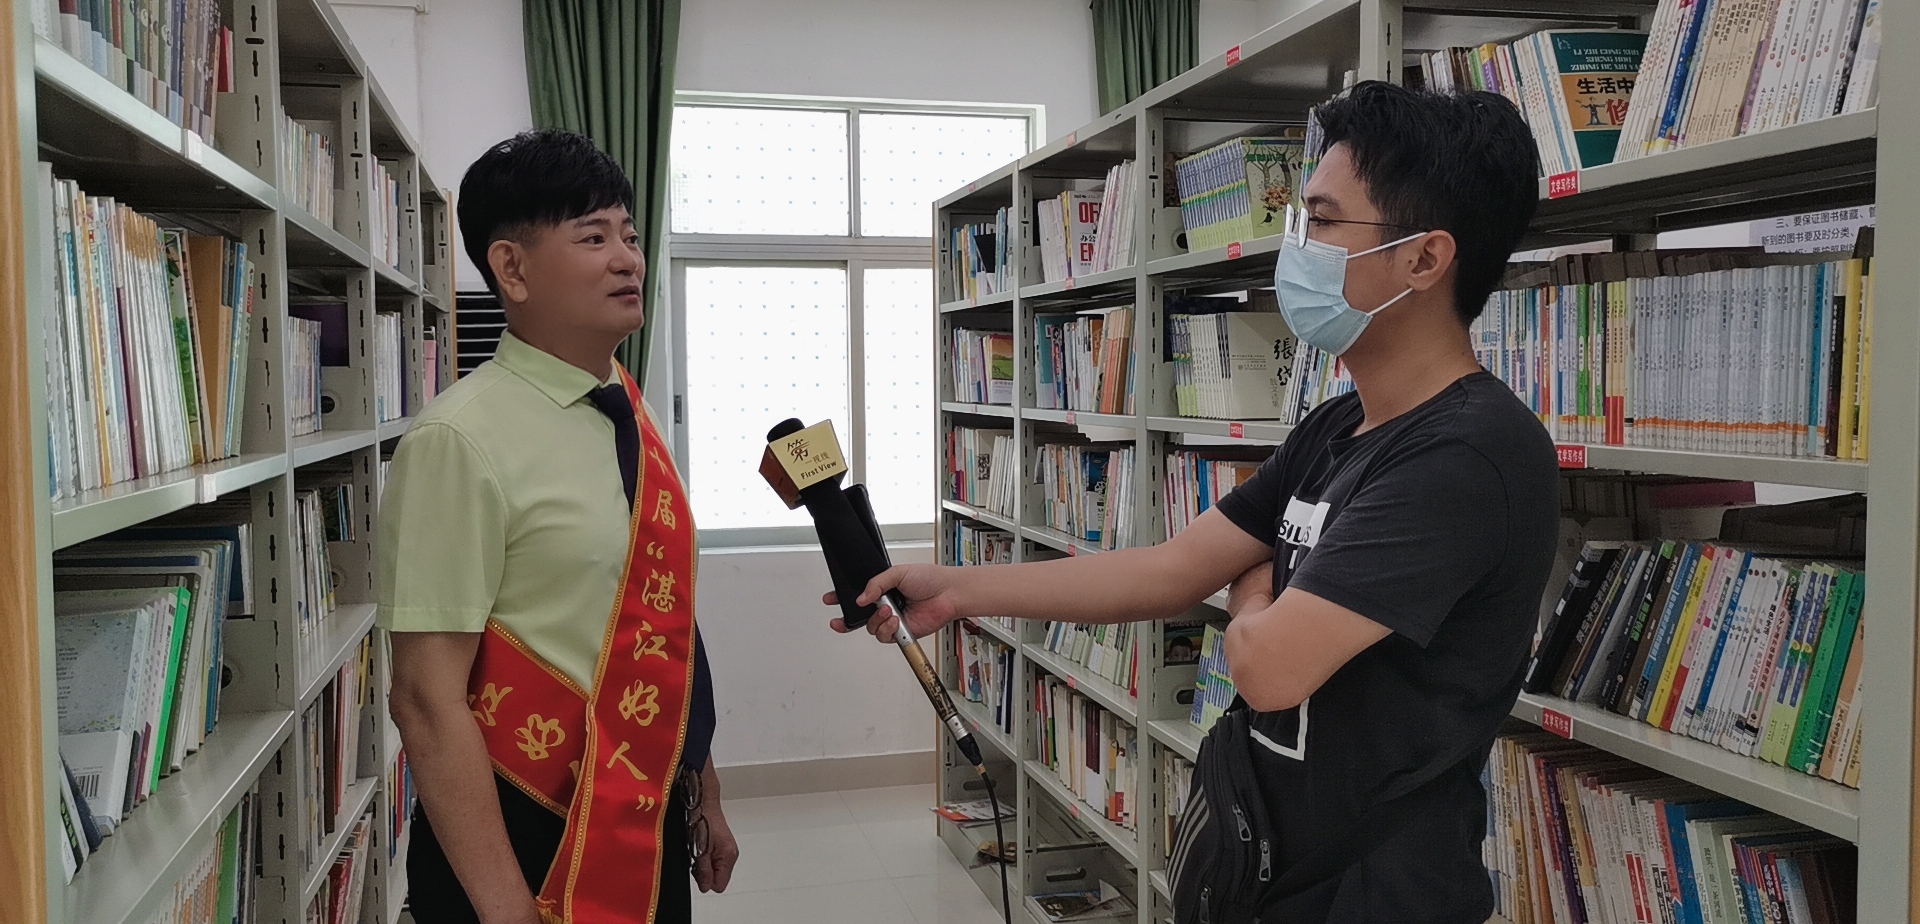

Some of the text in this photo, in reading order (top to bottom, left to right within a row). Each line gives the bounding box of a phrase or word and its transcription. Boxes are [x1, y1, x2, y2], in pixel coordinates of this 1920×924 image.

[1577, 77, 1634, 94] 生活中
[1550, 176, 1577, 193] 文学写作类
[1556, 449, 1583, 463] 文学写作类
[800, 460, 837, 480] First View
